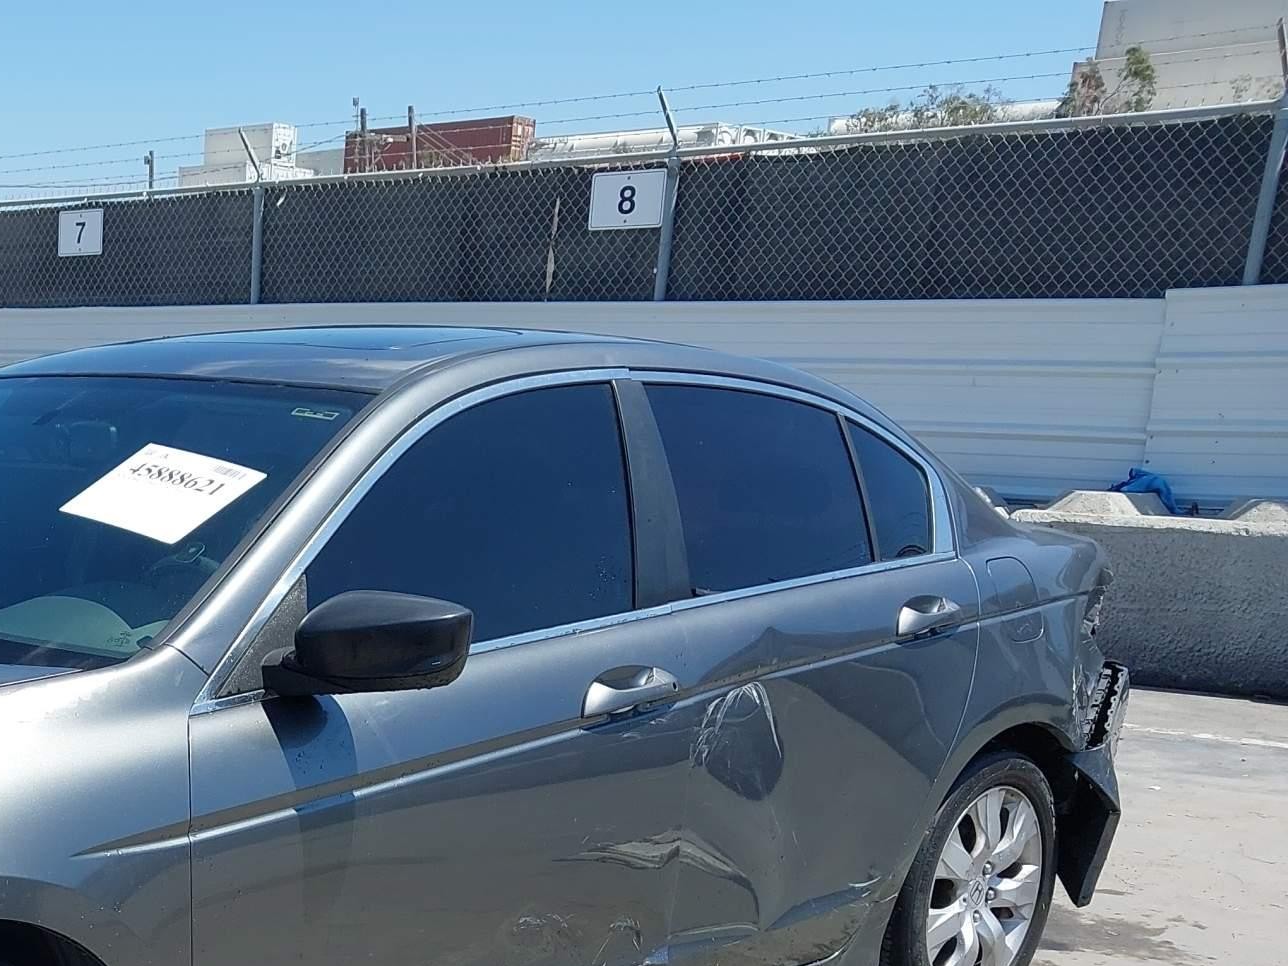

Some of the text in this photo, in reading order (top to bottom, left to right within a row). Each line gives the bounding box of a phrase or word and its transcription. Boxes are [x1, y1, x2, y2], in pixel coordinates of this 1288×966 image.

[618, 185, 636, 215] 8
[75, 221, 86, 244] 7
[128, 462, 226, 496] 45888621
